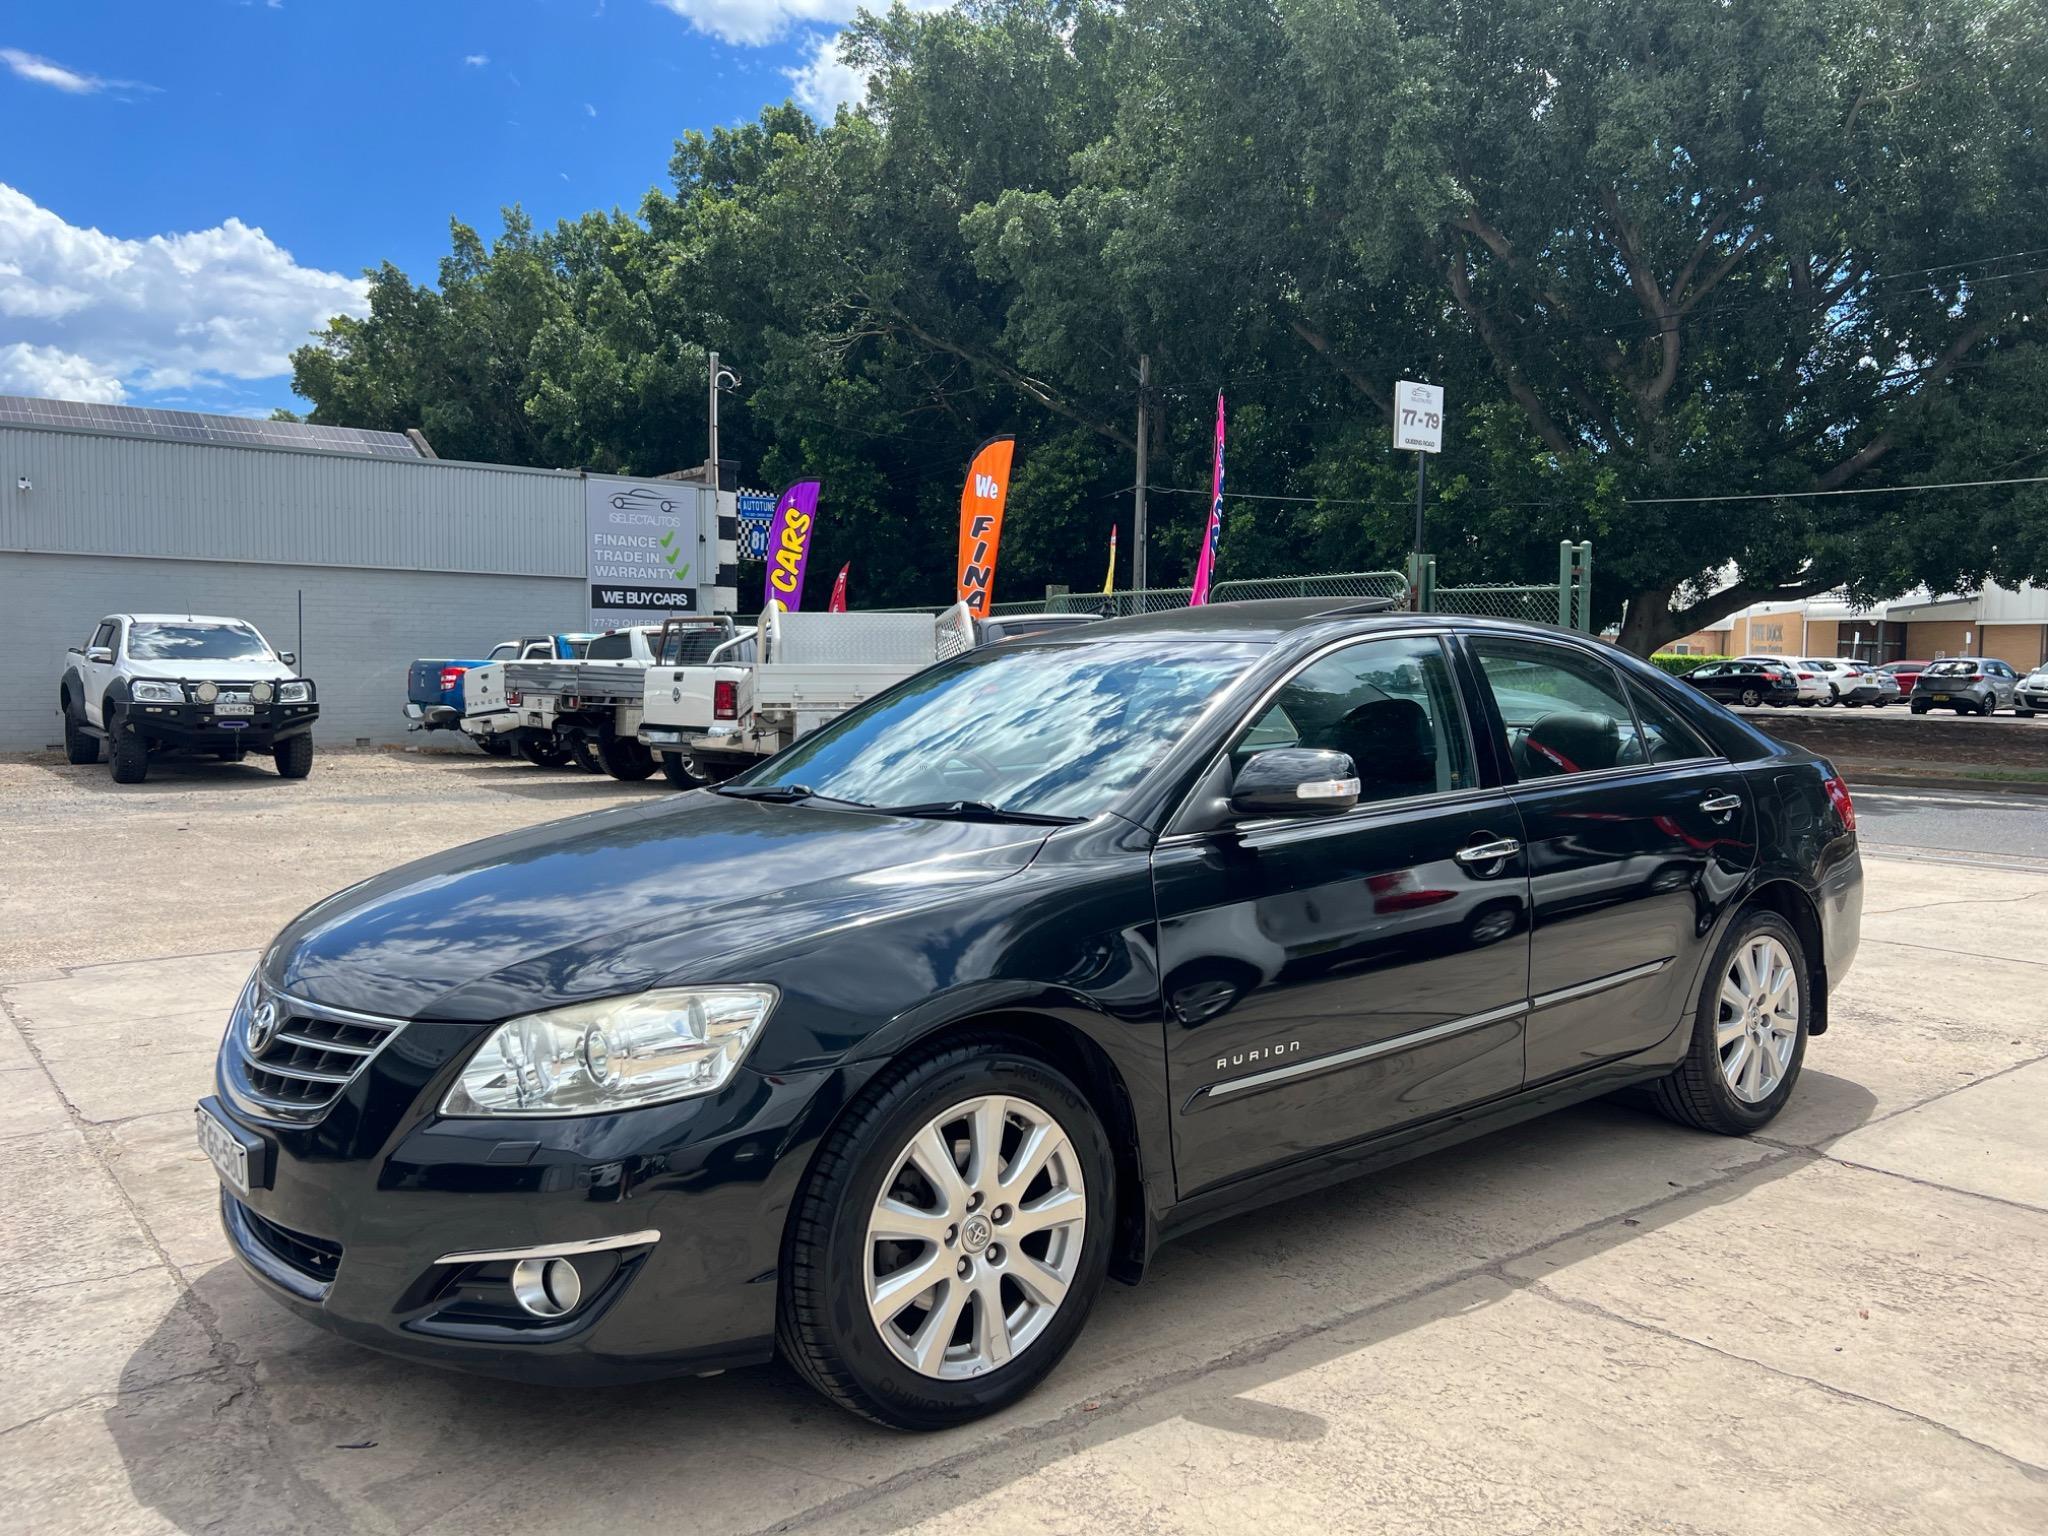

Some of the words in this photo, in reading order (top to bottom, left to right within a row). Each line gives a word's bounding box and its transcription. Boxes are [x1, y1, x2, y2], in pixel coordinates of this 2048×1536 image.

[975, 474, 998, 499] We
[743, 500, 776, 512] AUTOTUNE
[594, 533, 657, 548] FINANCE
[751, 531, 765, 551] 81
[594, 550, 643, 563] TRADE
[646, 552, 660, 564] IN
[770, 507, 811, 592] CARS
[594, 565, 676, 580] WARRANTY
[963, 515, 994, 618] FINA
[601, 591, 624, 604] WE
[626, 591, 653, 605] BUY
[653, 593, 688, 606] CARS
[467, 697, 507, 707] RANGE
[1216, 1040, 1300, 1070] AURION
